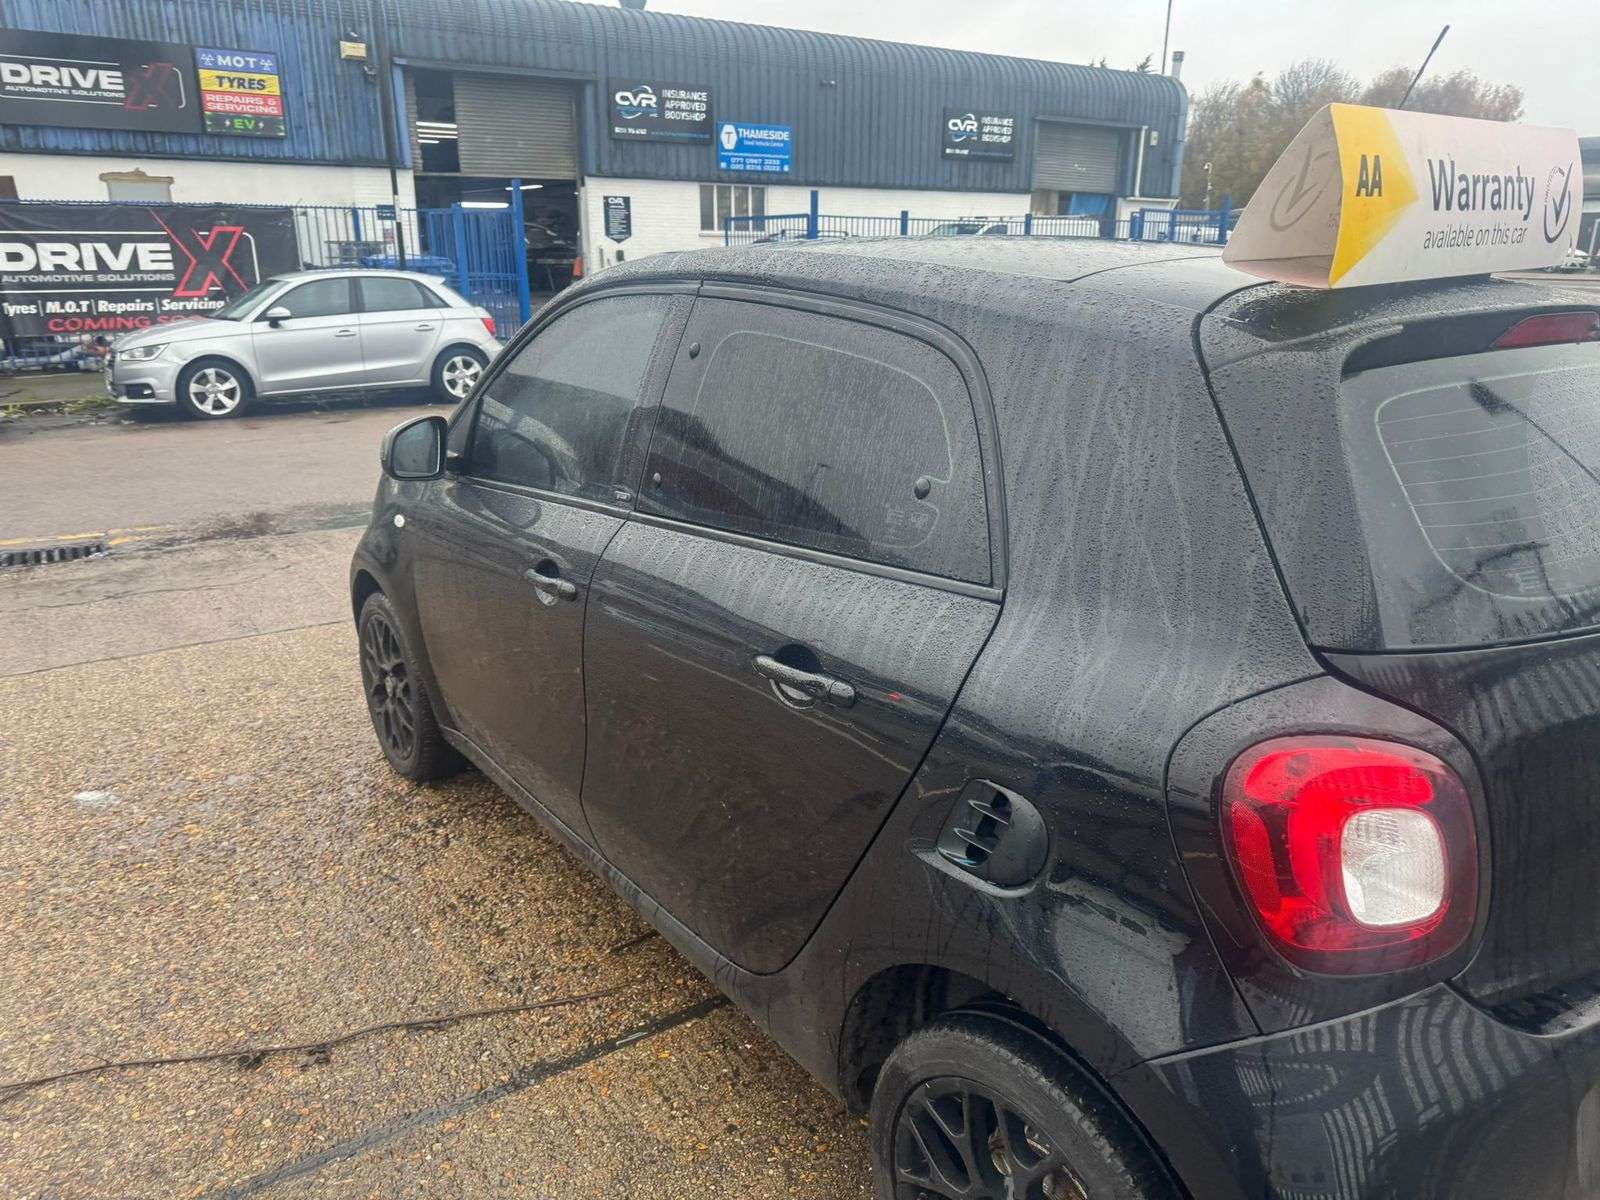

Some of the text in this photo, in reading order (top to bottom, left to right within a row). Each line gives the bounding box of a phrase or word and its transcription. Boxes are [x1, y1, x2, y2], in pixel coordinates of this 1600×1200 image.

[217, 54, 257, 68] MOT
[0, 62, 124, 91] DRIVE
[215, 75, 267, 90] TYRES
[5, 85, 126, 98] AUTOMOTIVE SOLUTIONS
[662, 89, 708, 102] INSURANCE
[207, 94, 276, 106] REPAIRS &
[615, 91, 657, 108] CVR
[664, 99, 707, 111] APPROVED
[206, 102, 279, 114] SERVICING
[234, 118, 256, 131] EV
[948, 118, 978, 132] CVR
[737, 128, 790, 141] THAMESIDE
[1355, 154, 1383, 198] AA
[1427, 157, 1536, 221] Warranty
[1423, 223, 1527, 249] available on this car
[0, 216, 249, 297] DRIVE X
[2, 272, 176, 283] AUTOMOTIVE SOLUTIONS
[2, 298, 225, 317] Tyres M.O.T Repairs Servicing
[48, 316, 151, 332] COMING
